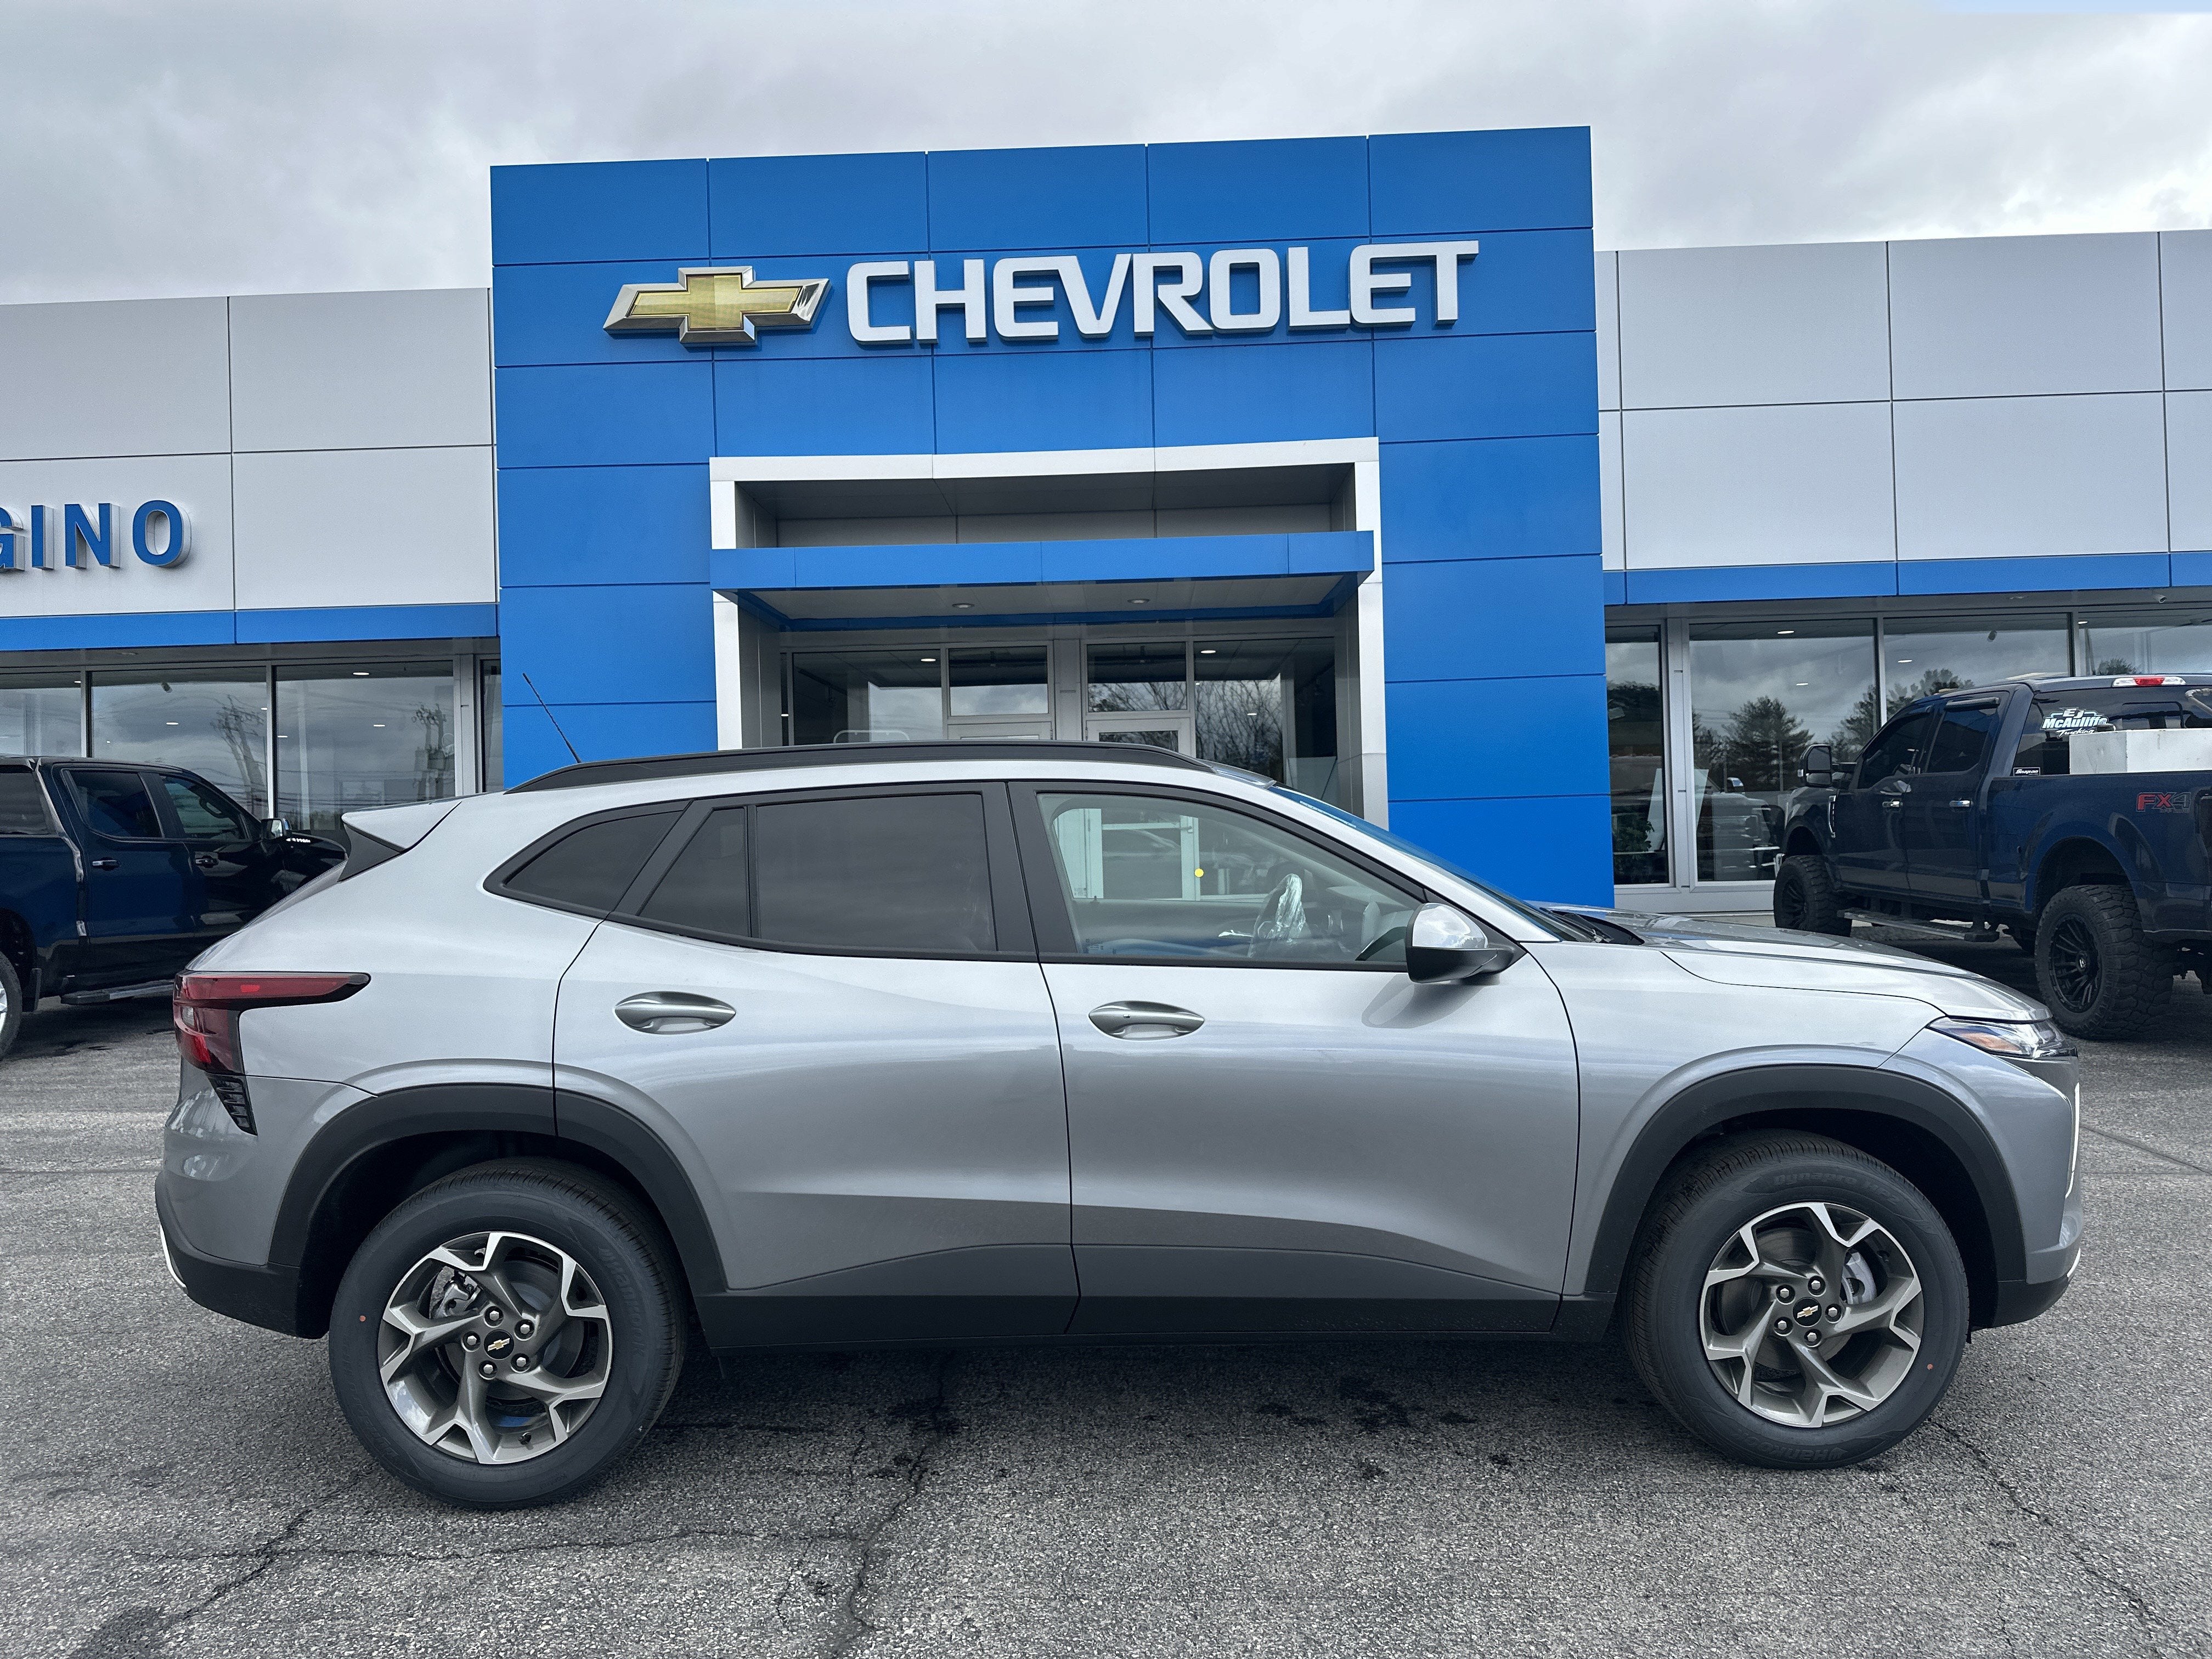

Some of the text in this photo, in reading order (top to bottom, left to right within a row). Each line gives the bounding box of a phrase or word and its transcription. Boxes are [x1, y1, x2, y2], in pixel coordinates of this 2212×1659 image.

[847, 239, 1480, 346] CHEVROLET
[2042, 716, 2108, 729] McAuliffe
[2056, 727, 2095, 738] Trucking
[2136, 792, 2191, 812] FX4
